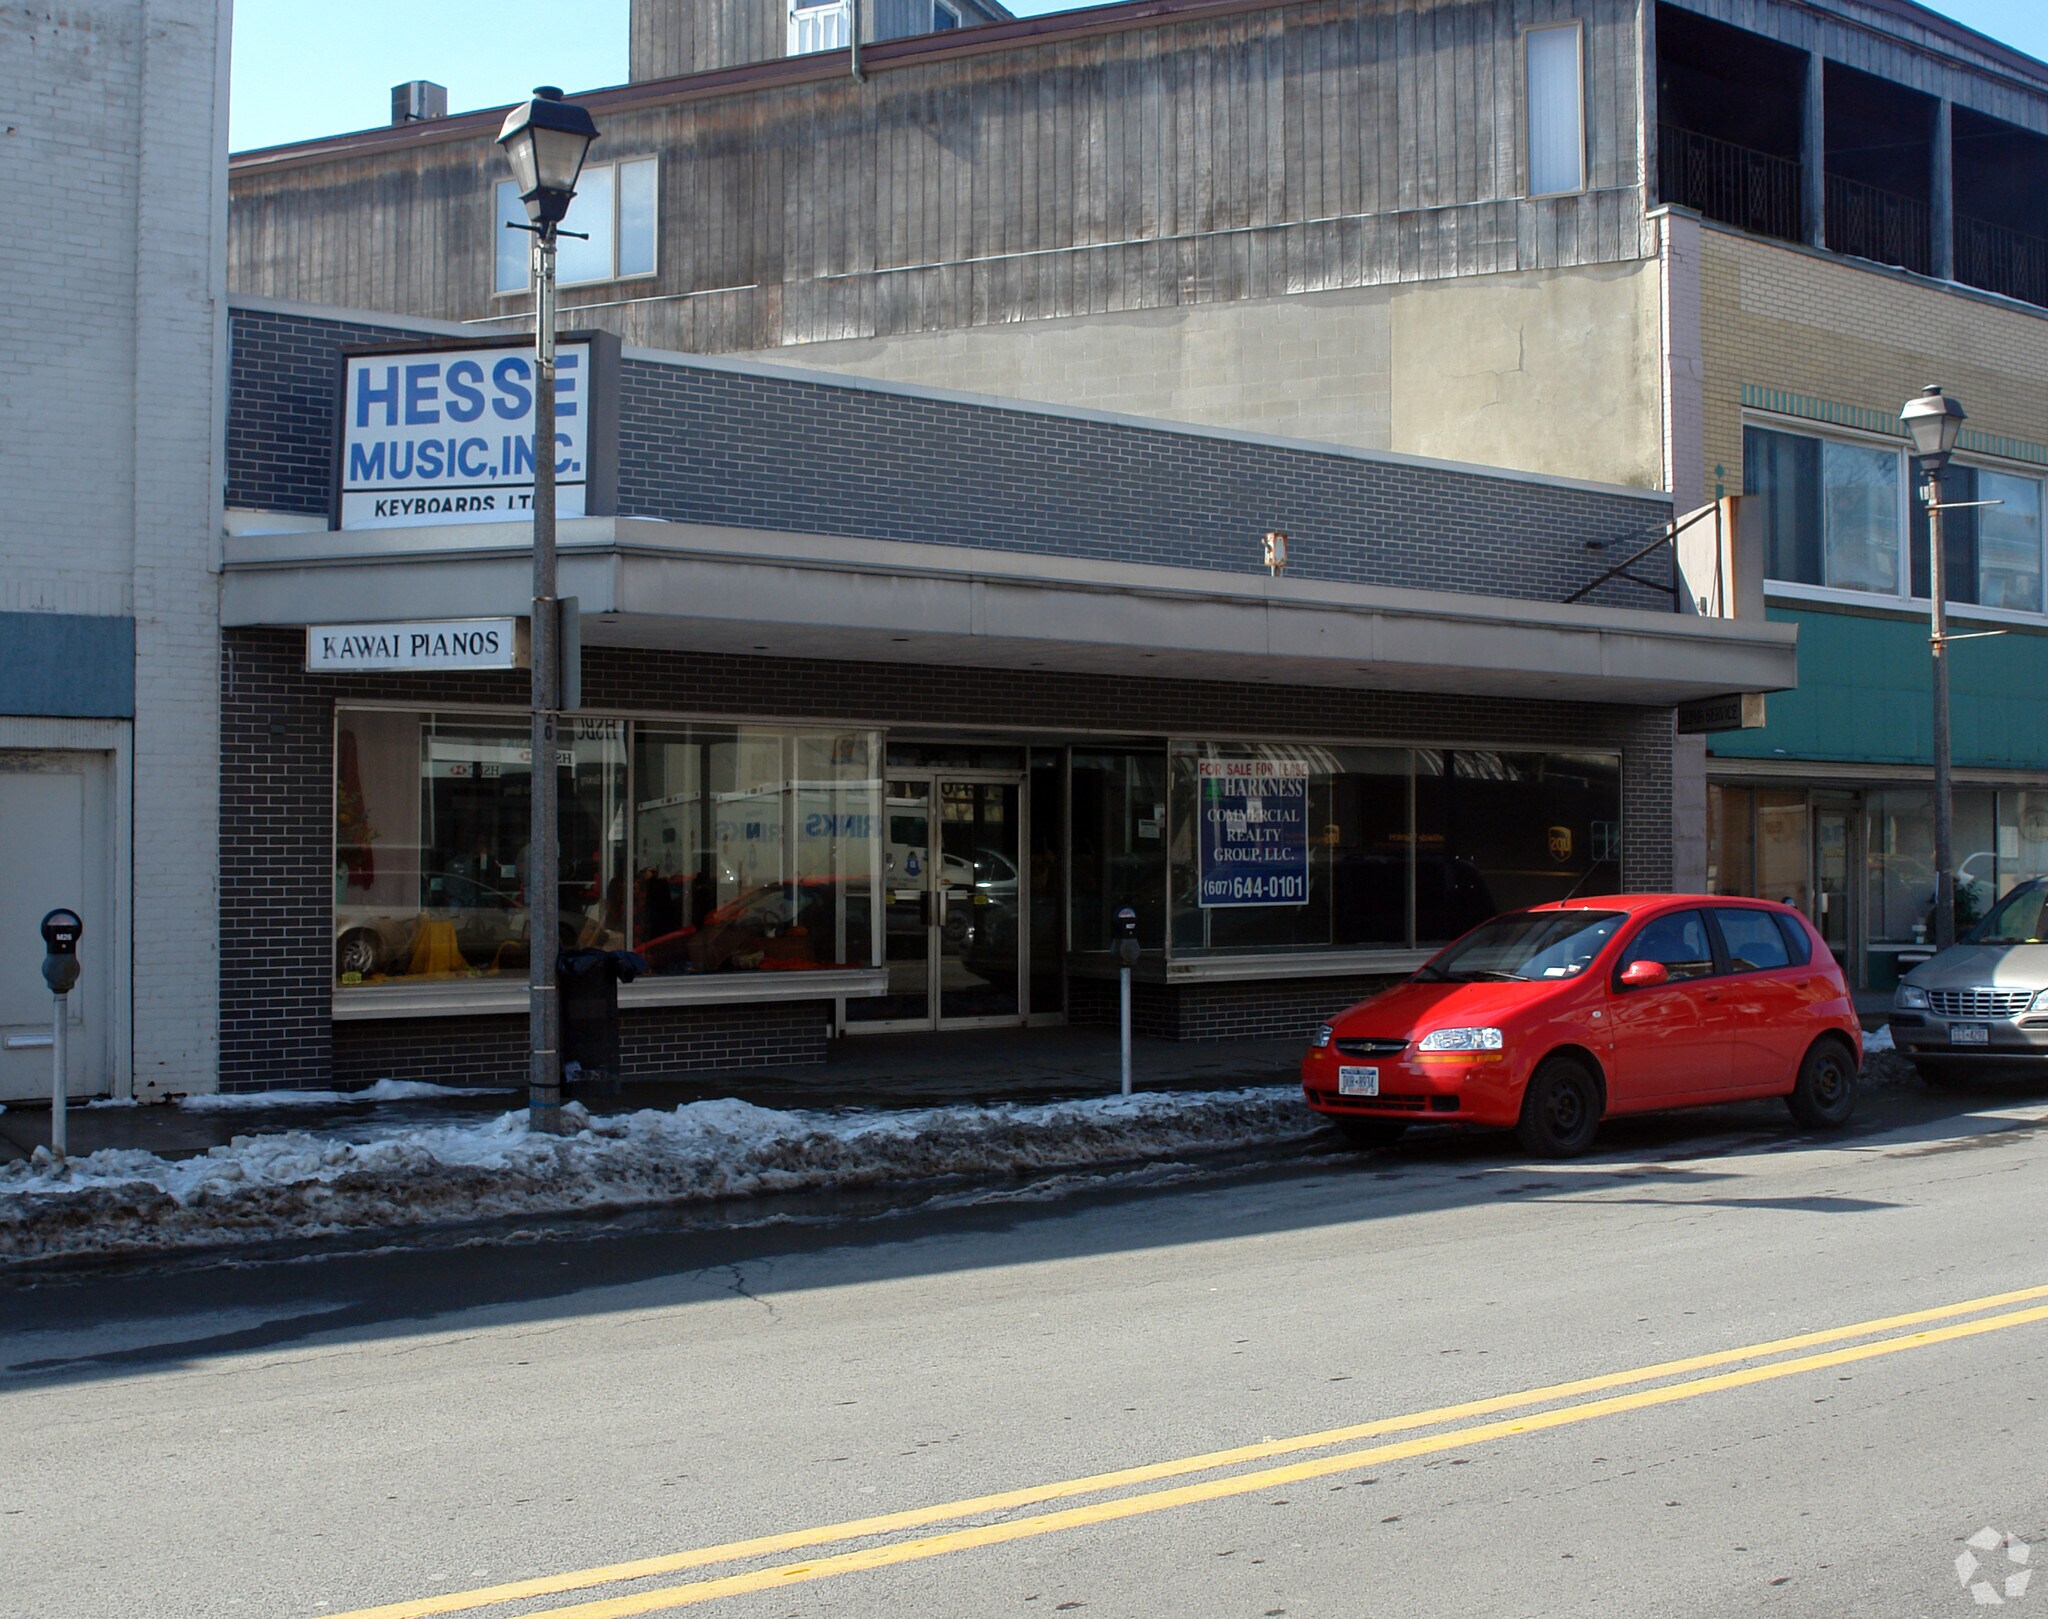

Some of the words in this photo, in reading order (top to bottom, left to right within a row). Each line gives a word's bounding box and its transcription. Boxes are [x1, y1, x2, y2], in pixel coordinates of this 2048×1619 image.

[356, 353, 579, 428] HESSE
[374, 494, 496, 517] KEYBOARDS
[322, 634, 400, 660] KAWAI
[410, 631, 500, 659] PIANOS
[1200, 763, 1221, 776] FOR
[1227, 763, 1252, 776] SALE
[1256, 762, 1273, 776] FOR
[1225, 778, 1304, 798] HARKNESS
[1207, 808, 1300, 823] COMMERCIAL
[1227, 828, 1282, 842] REALTY
[1213, 847, 1262, 863] GROUP,
[1265, 847, 1295, 861] LLC.
